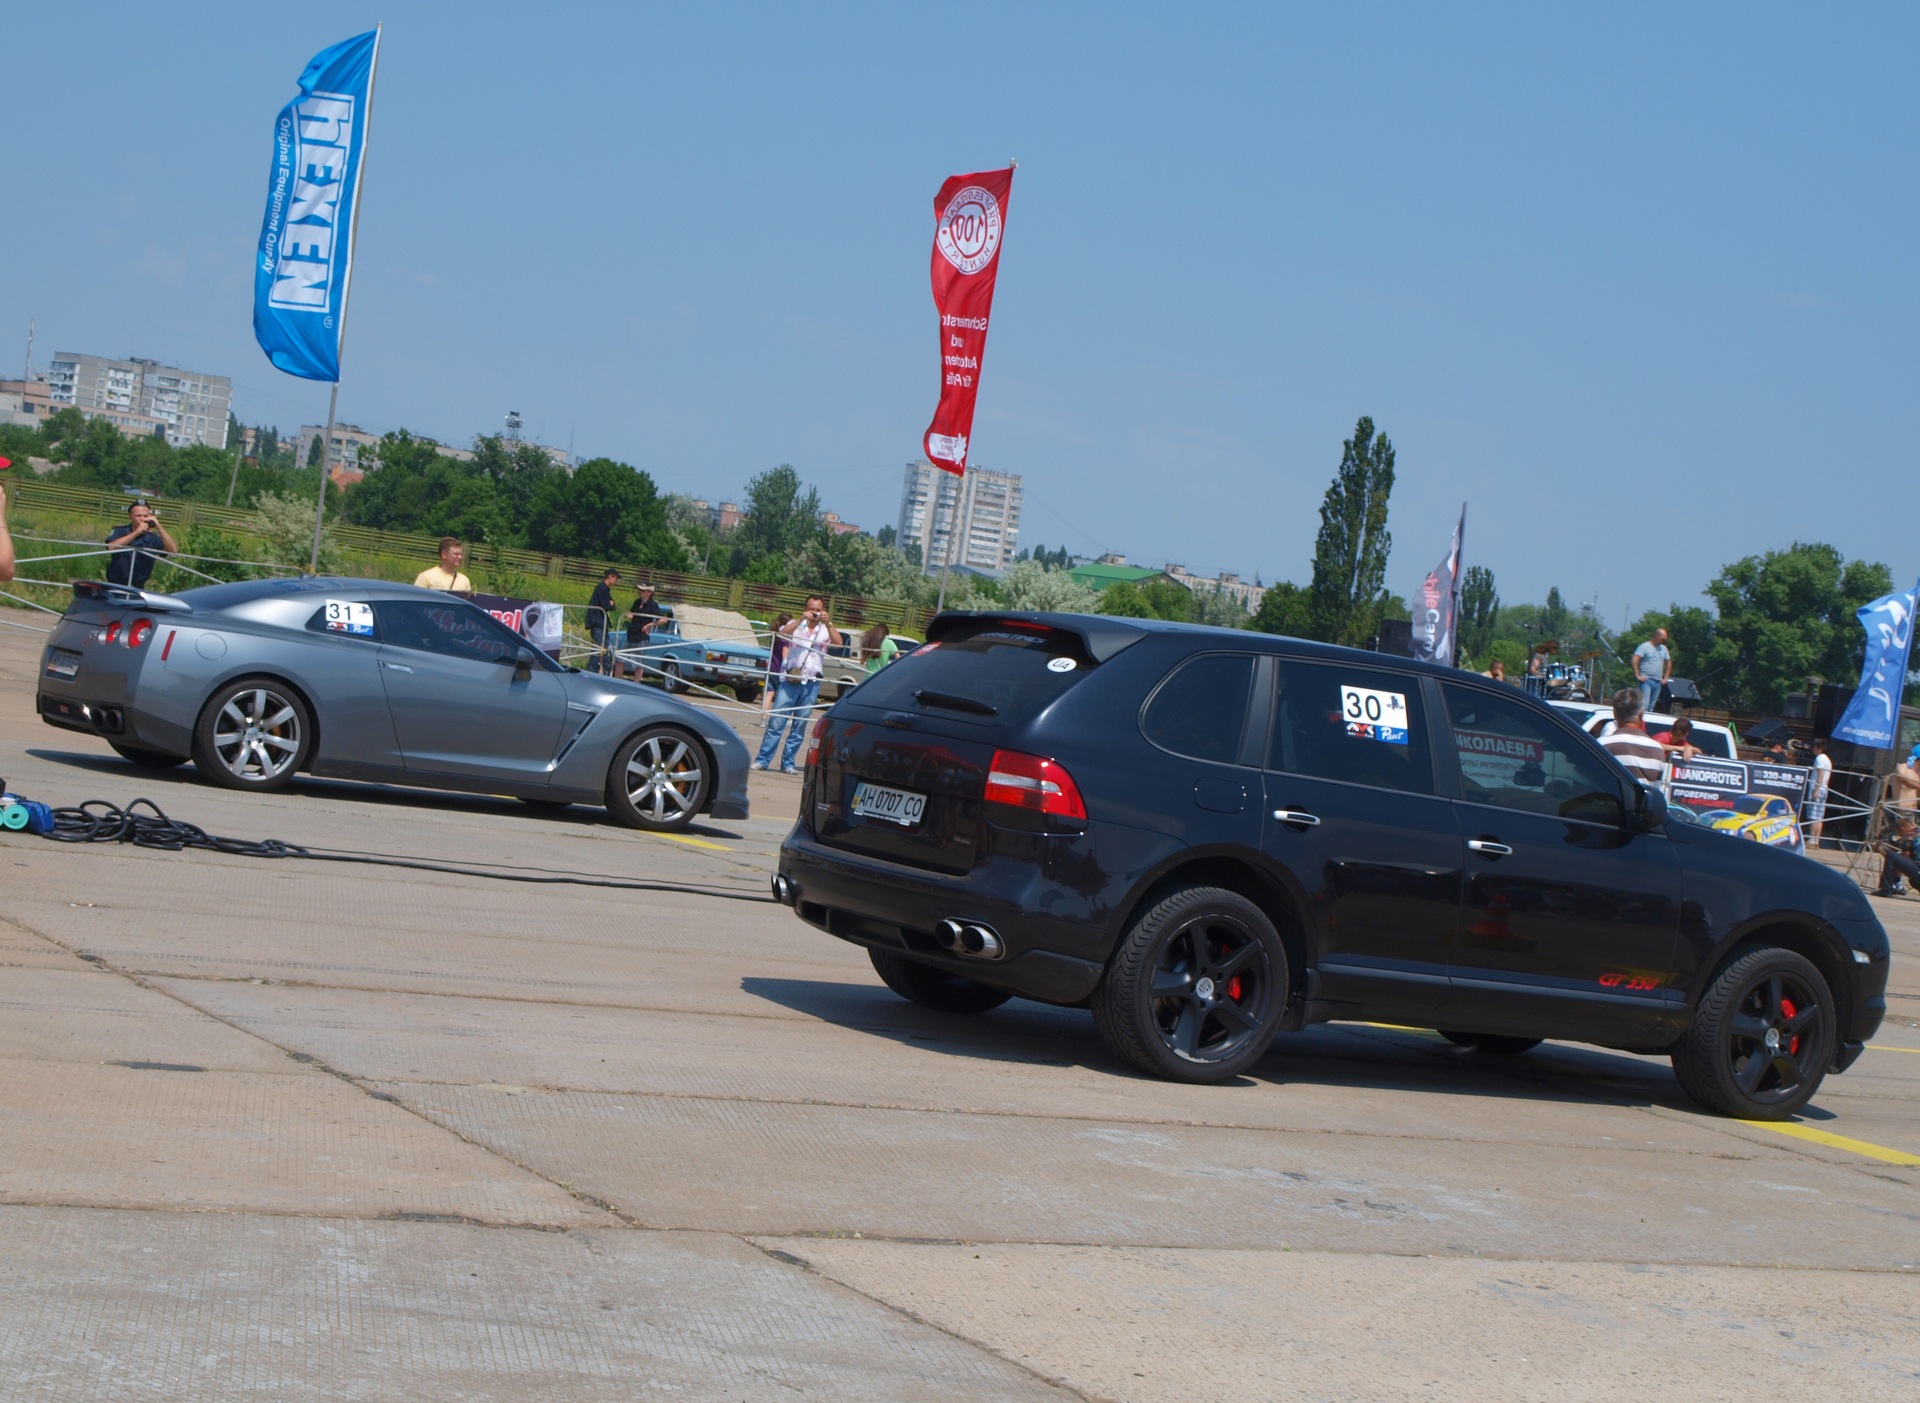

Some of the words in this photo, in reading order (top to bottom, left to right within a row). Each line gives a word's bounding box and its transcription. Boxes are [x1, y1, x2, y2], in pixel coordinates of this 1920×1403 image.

[278, 117, 291, 166] Original
[268, 168, 289, 232] Equipment
[329, 603, 350, 621] 31
[1052, 659, 1071, 670] UA
[1346, 692, 1381, 721] 30
[1675, 766, 1742, 786] NANOPROTEC
[858, 787, 877, 807] AH
[875, 790, 904, 813] 0707
[903, 796, 922, 817] CO
[1598, 973, 1629, 987] GT
